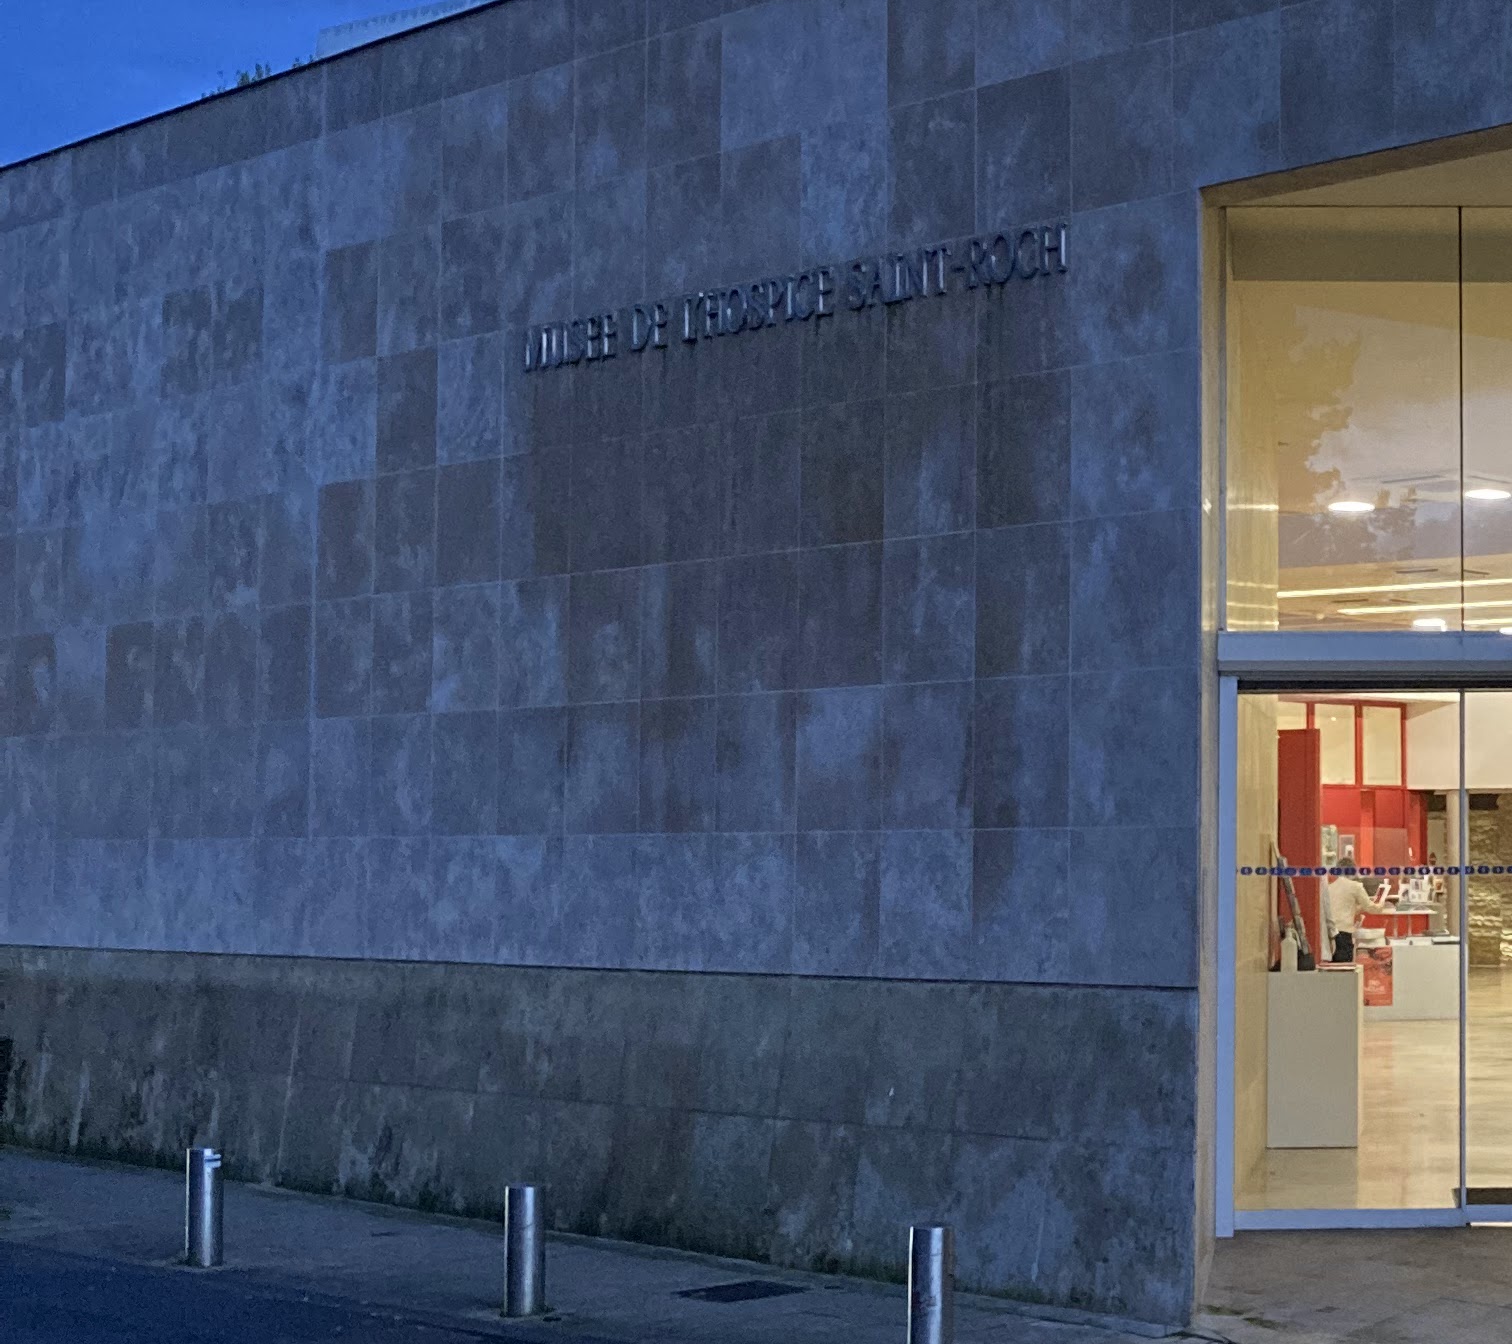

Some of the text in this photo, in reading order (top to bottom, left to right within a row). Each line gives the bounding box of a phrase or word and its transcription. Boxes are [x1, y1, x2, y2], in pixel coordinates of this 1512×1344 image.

[631, 302, 668, 352] DE
[682, 266, 833, 344] L'HOSPICE
[849, 222, 1068, 311] SAINT-ROCH
